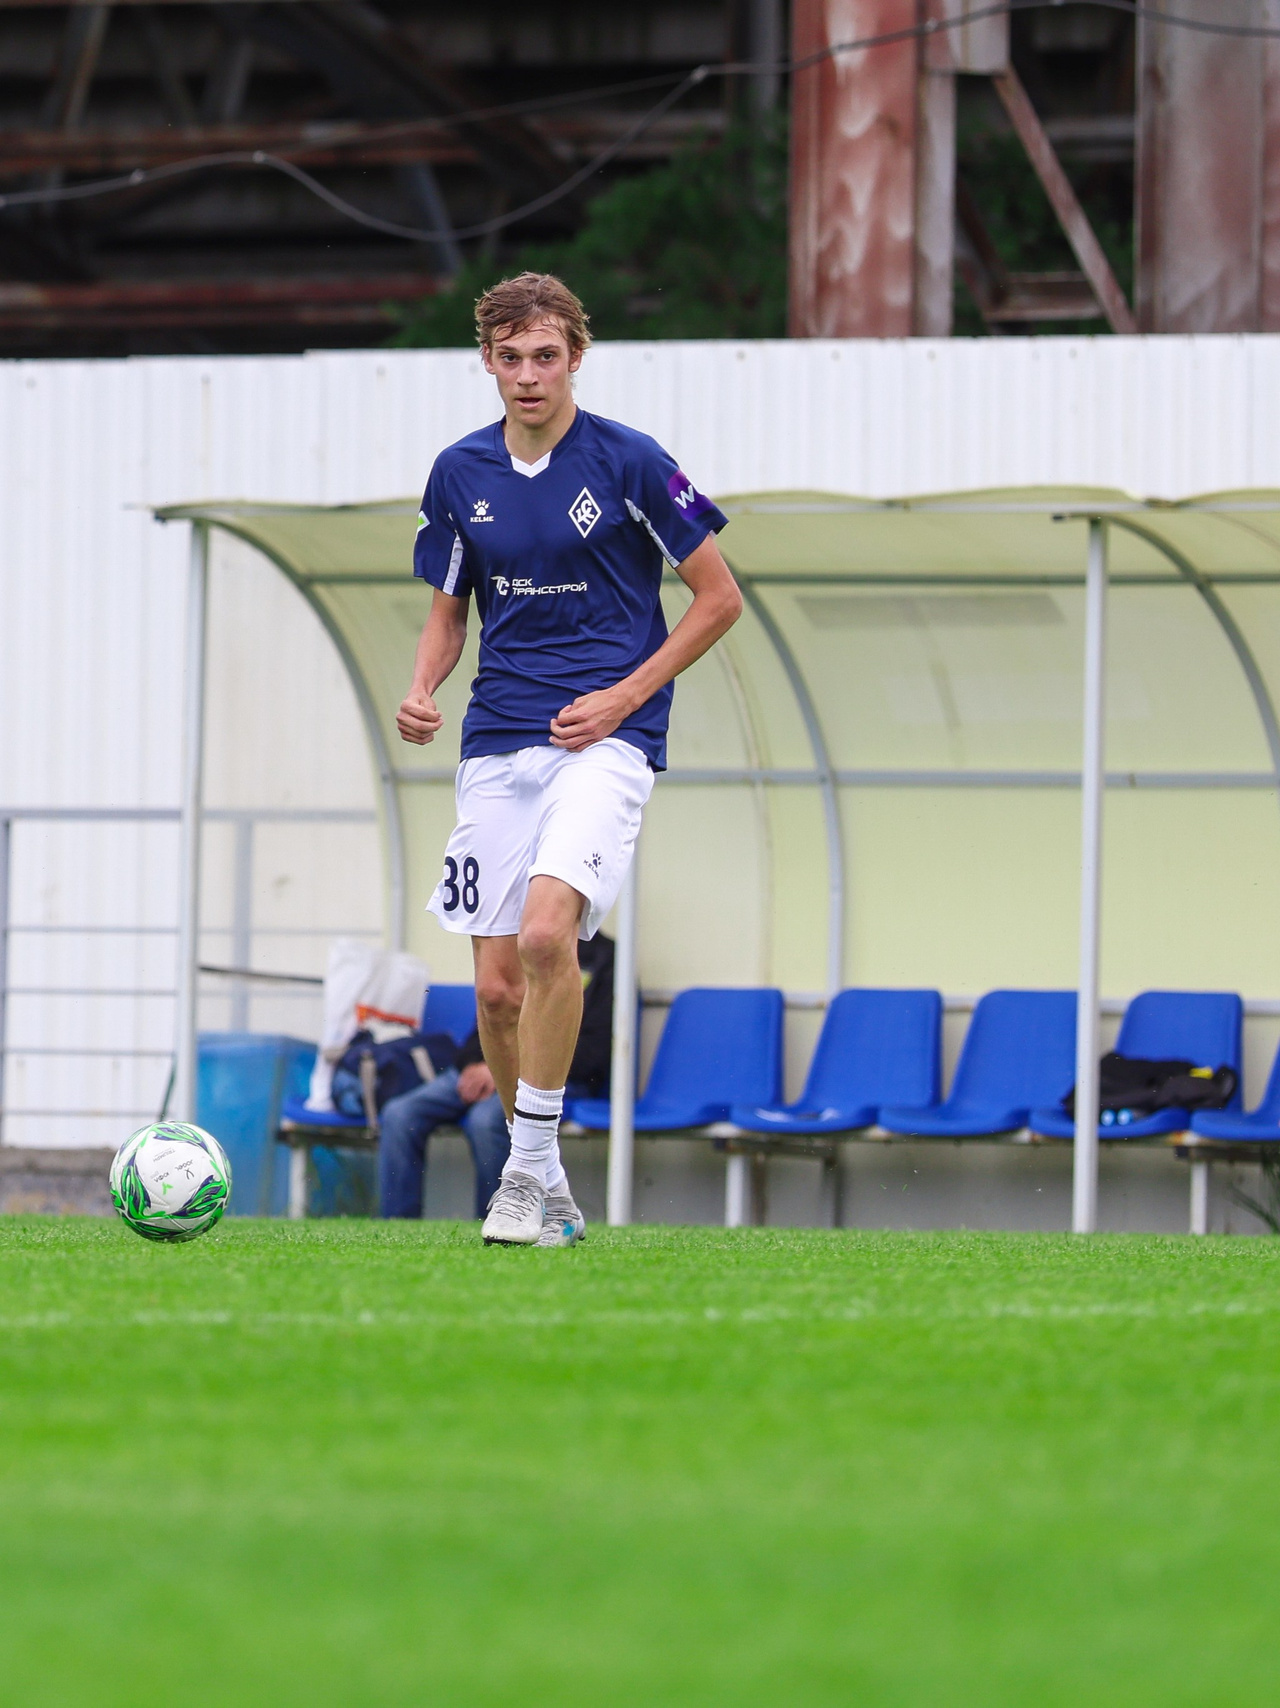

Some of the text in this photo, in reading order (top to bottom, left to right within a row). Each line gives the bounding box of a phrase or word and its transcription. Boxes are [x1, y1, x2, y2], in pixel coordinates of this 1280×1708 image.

[674, 484, 695, 510] W
[470, 515, 495, 523] KELME
[512, 577, 533, 587] ДСК
[512, 581, 588, 596] ТРАНССТРОЙ
[442, 856, 480, 915] 38
